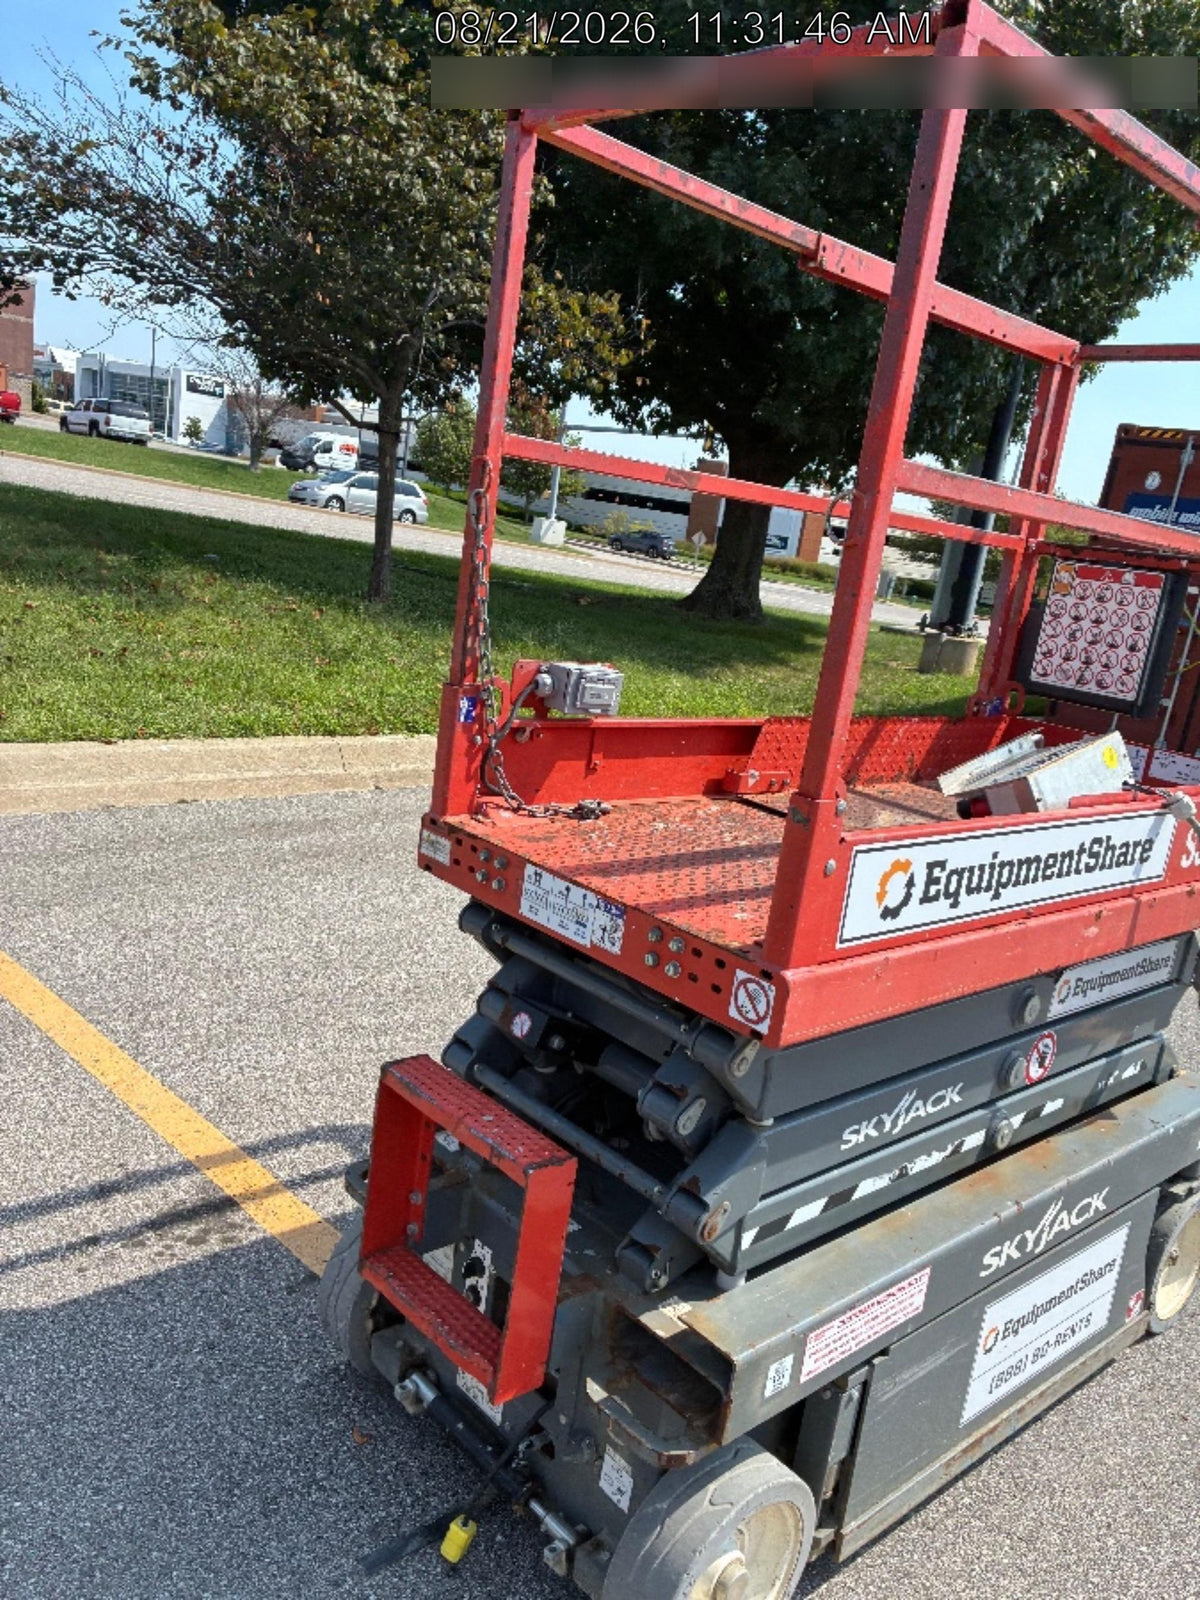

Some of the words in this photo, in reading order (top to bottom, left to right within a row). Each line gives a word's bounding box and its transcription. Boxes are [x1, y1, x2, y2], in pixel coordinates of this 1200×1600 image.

[919, 835, 1154, 909] EquipmentShare
[1072, 956, 1171, 997] EquipmentShare
[840, 1082, 964, 1151] SKYJACK
[979, 1186, 1110, 1277] SKYJACK
[1001, 1258, 1118, 1341] EquipmentShare
[988, 1354, 1029, 1395] (888)
